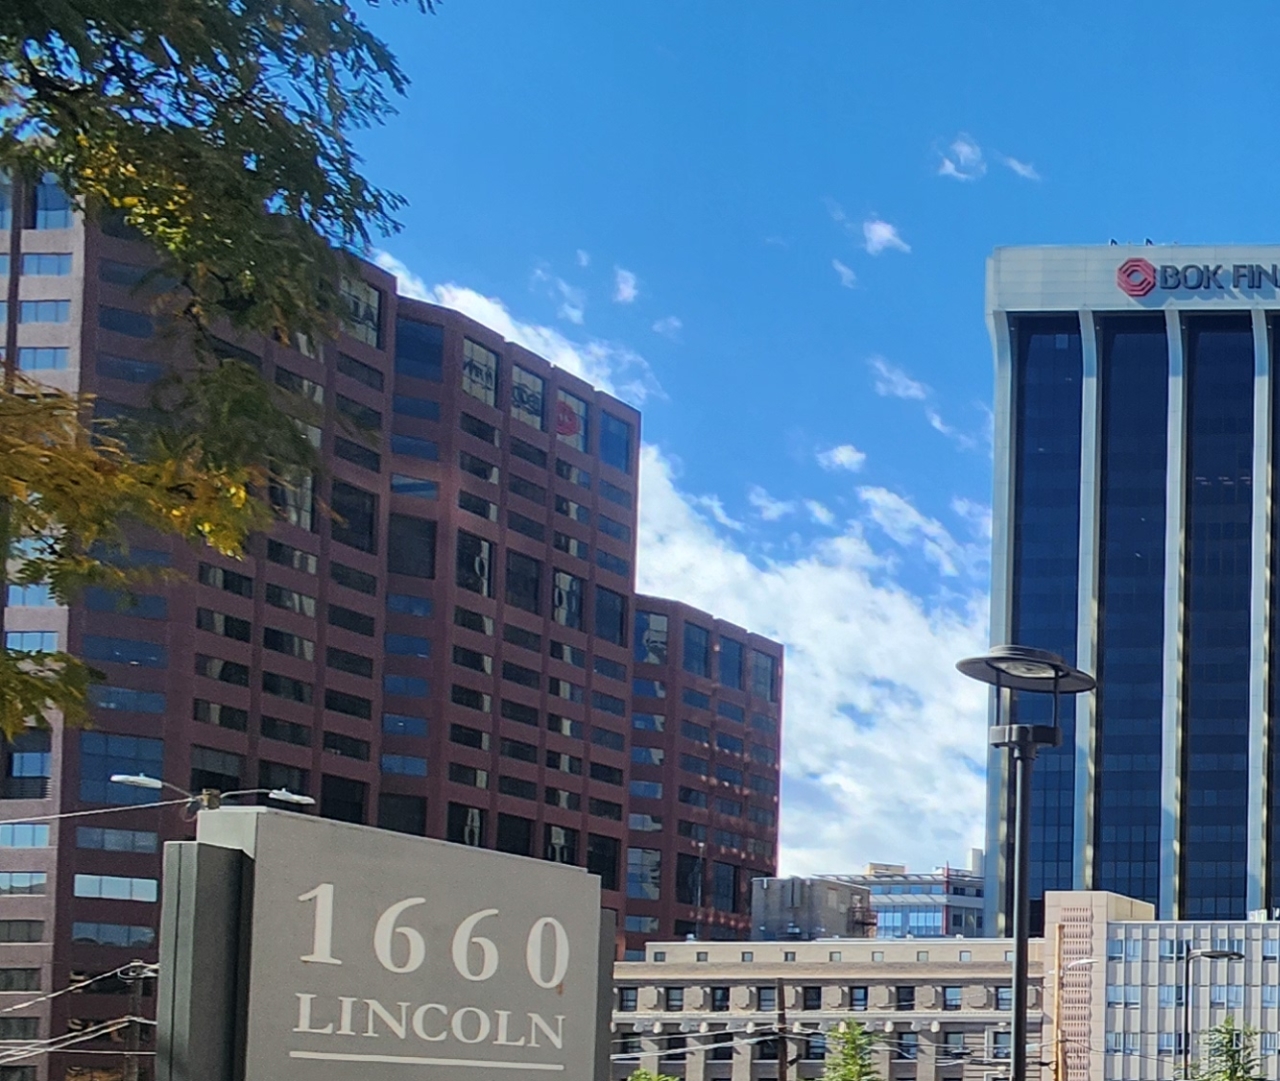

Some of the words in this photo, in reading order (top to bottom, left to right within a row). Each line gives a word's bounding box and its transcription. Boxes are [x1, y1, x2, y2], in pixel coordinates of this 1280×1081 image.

[1159, 264, 1225, 290] BOK
[297, 882, 571, 989] 1660
[292, 992, 566, 1050] LINCOLN
